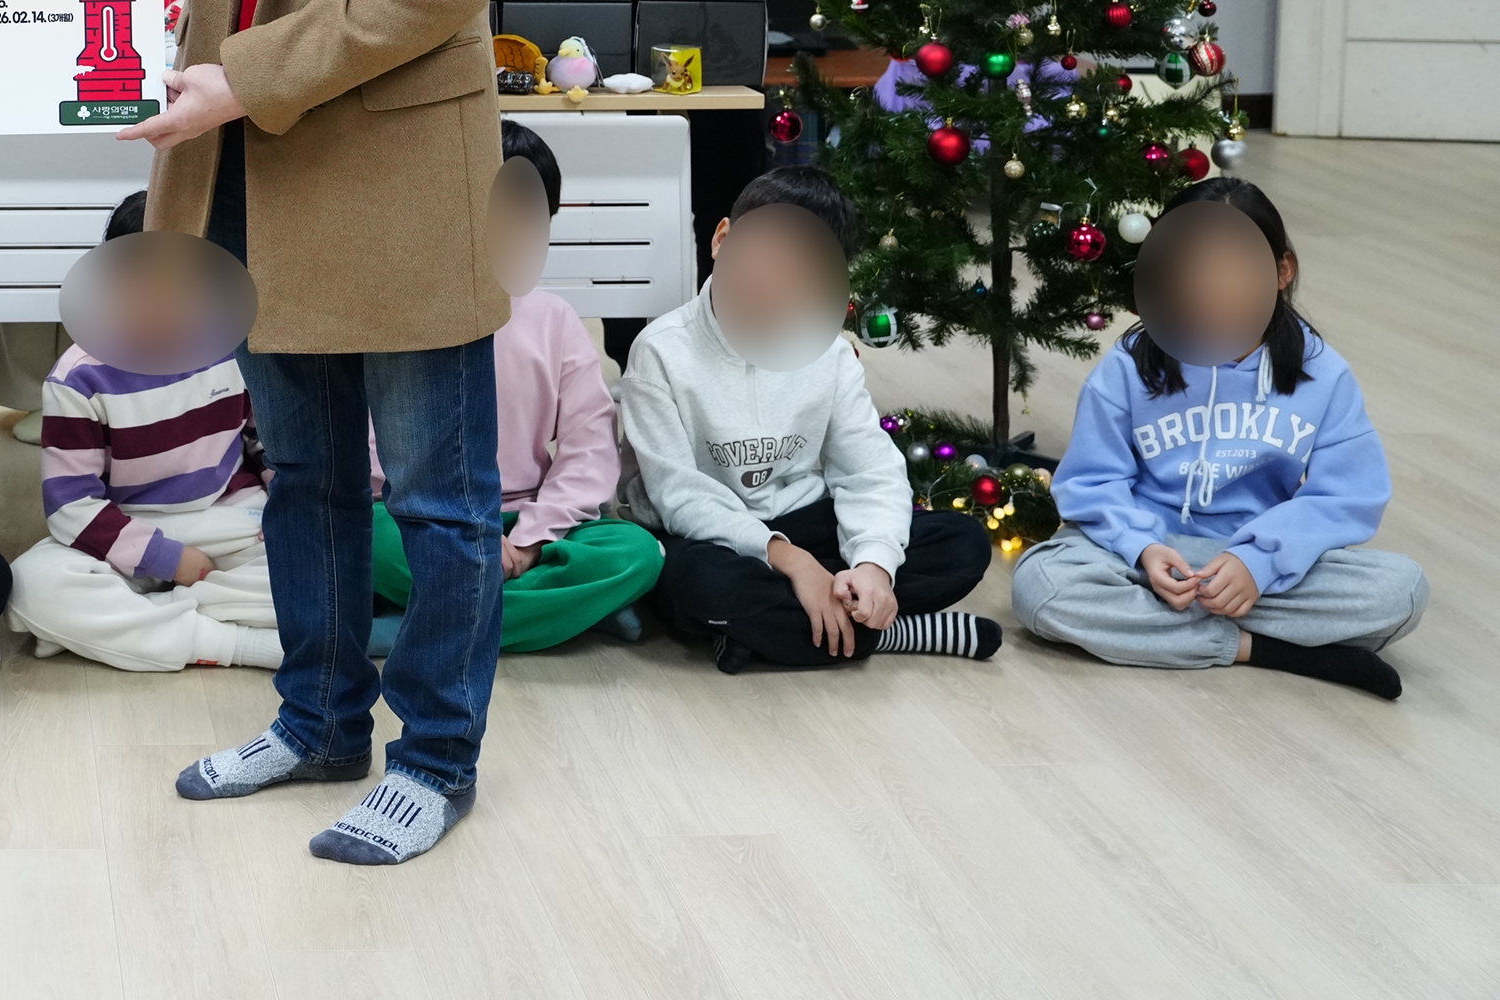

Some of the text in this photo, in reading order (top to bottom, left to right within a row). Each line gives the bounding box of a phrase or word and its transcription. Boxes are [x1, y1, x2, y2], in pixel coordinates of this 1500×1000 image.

[92, 105, 139, 115] 사랑의열매
[1215, 449, 1257, 459] EST.2013
[752, 471, 767, 486] 08
